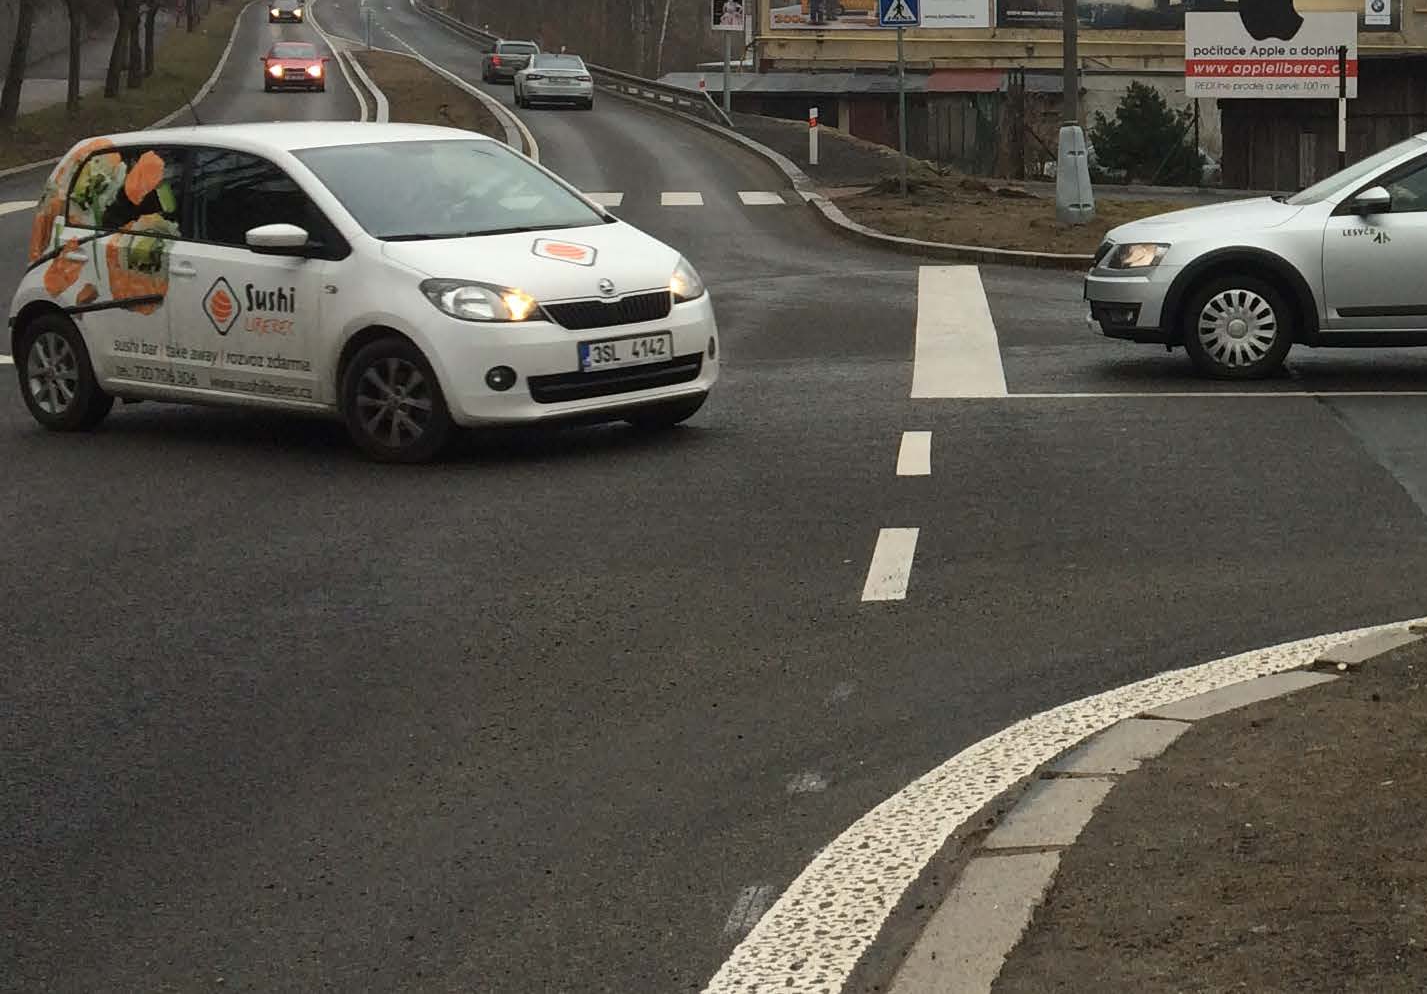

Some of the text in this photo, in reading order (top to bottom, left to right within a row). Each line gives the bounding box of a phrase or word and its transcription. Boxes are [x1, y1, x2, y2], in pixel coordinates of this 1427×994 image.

[1250, 46, 1285, 57] Apple
[1301, 46, 1348, 57] doplňk
[245, 283, 295, 313] Sushi
[592, 338, 665, 363] 3SL 4142
